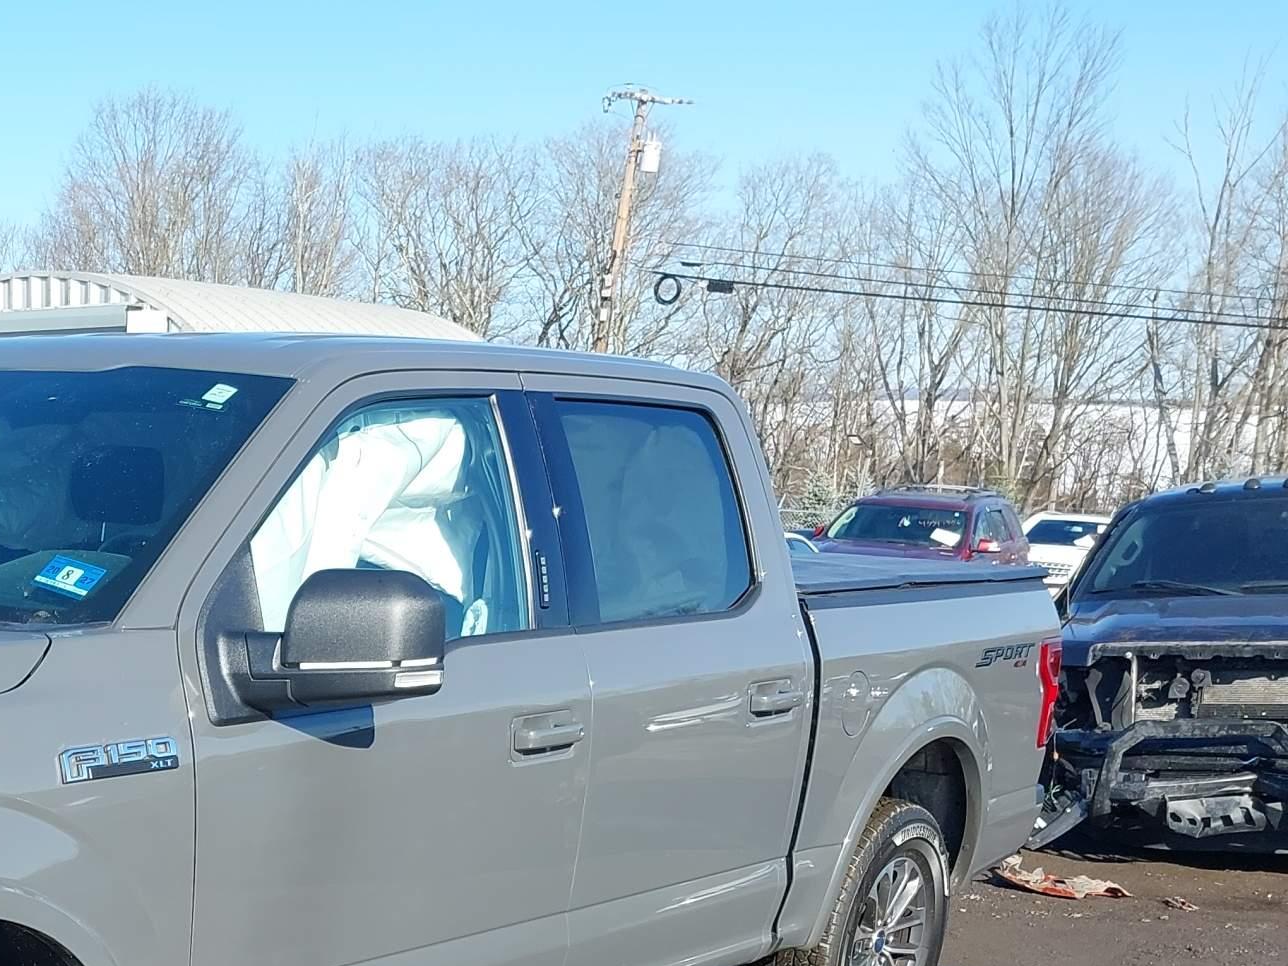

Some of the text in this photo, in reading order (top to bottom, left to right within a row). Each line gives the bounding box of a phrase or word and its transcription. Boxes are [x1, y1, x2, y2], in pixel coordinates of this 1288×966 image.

[61, 569, 74, 580] 8
[975, 643, 1035, 668] SPORT
[150, 758, 173, 769] XLT
